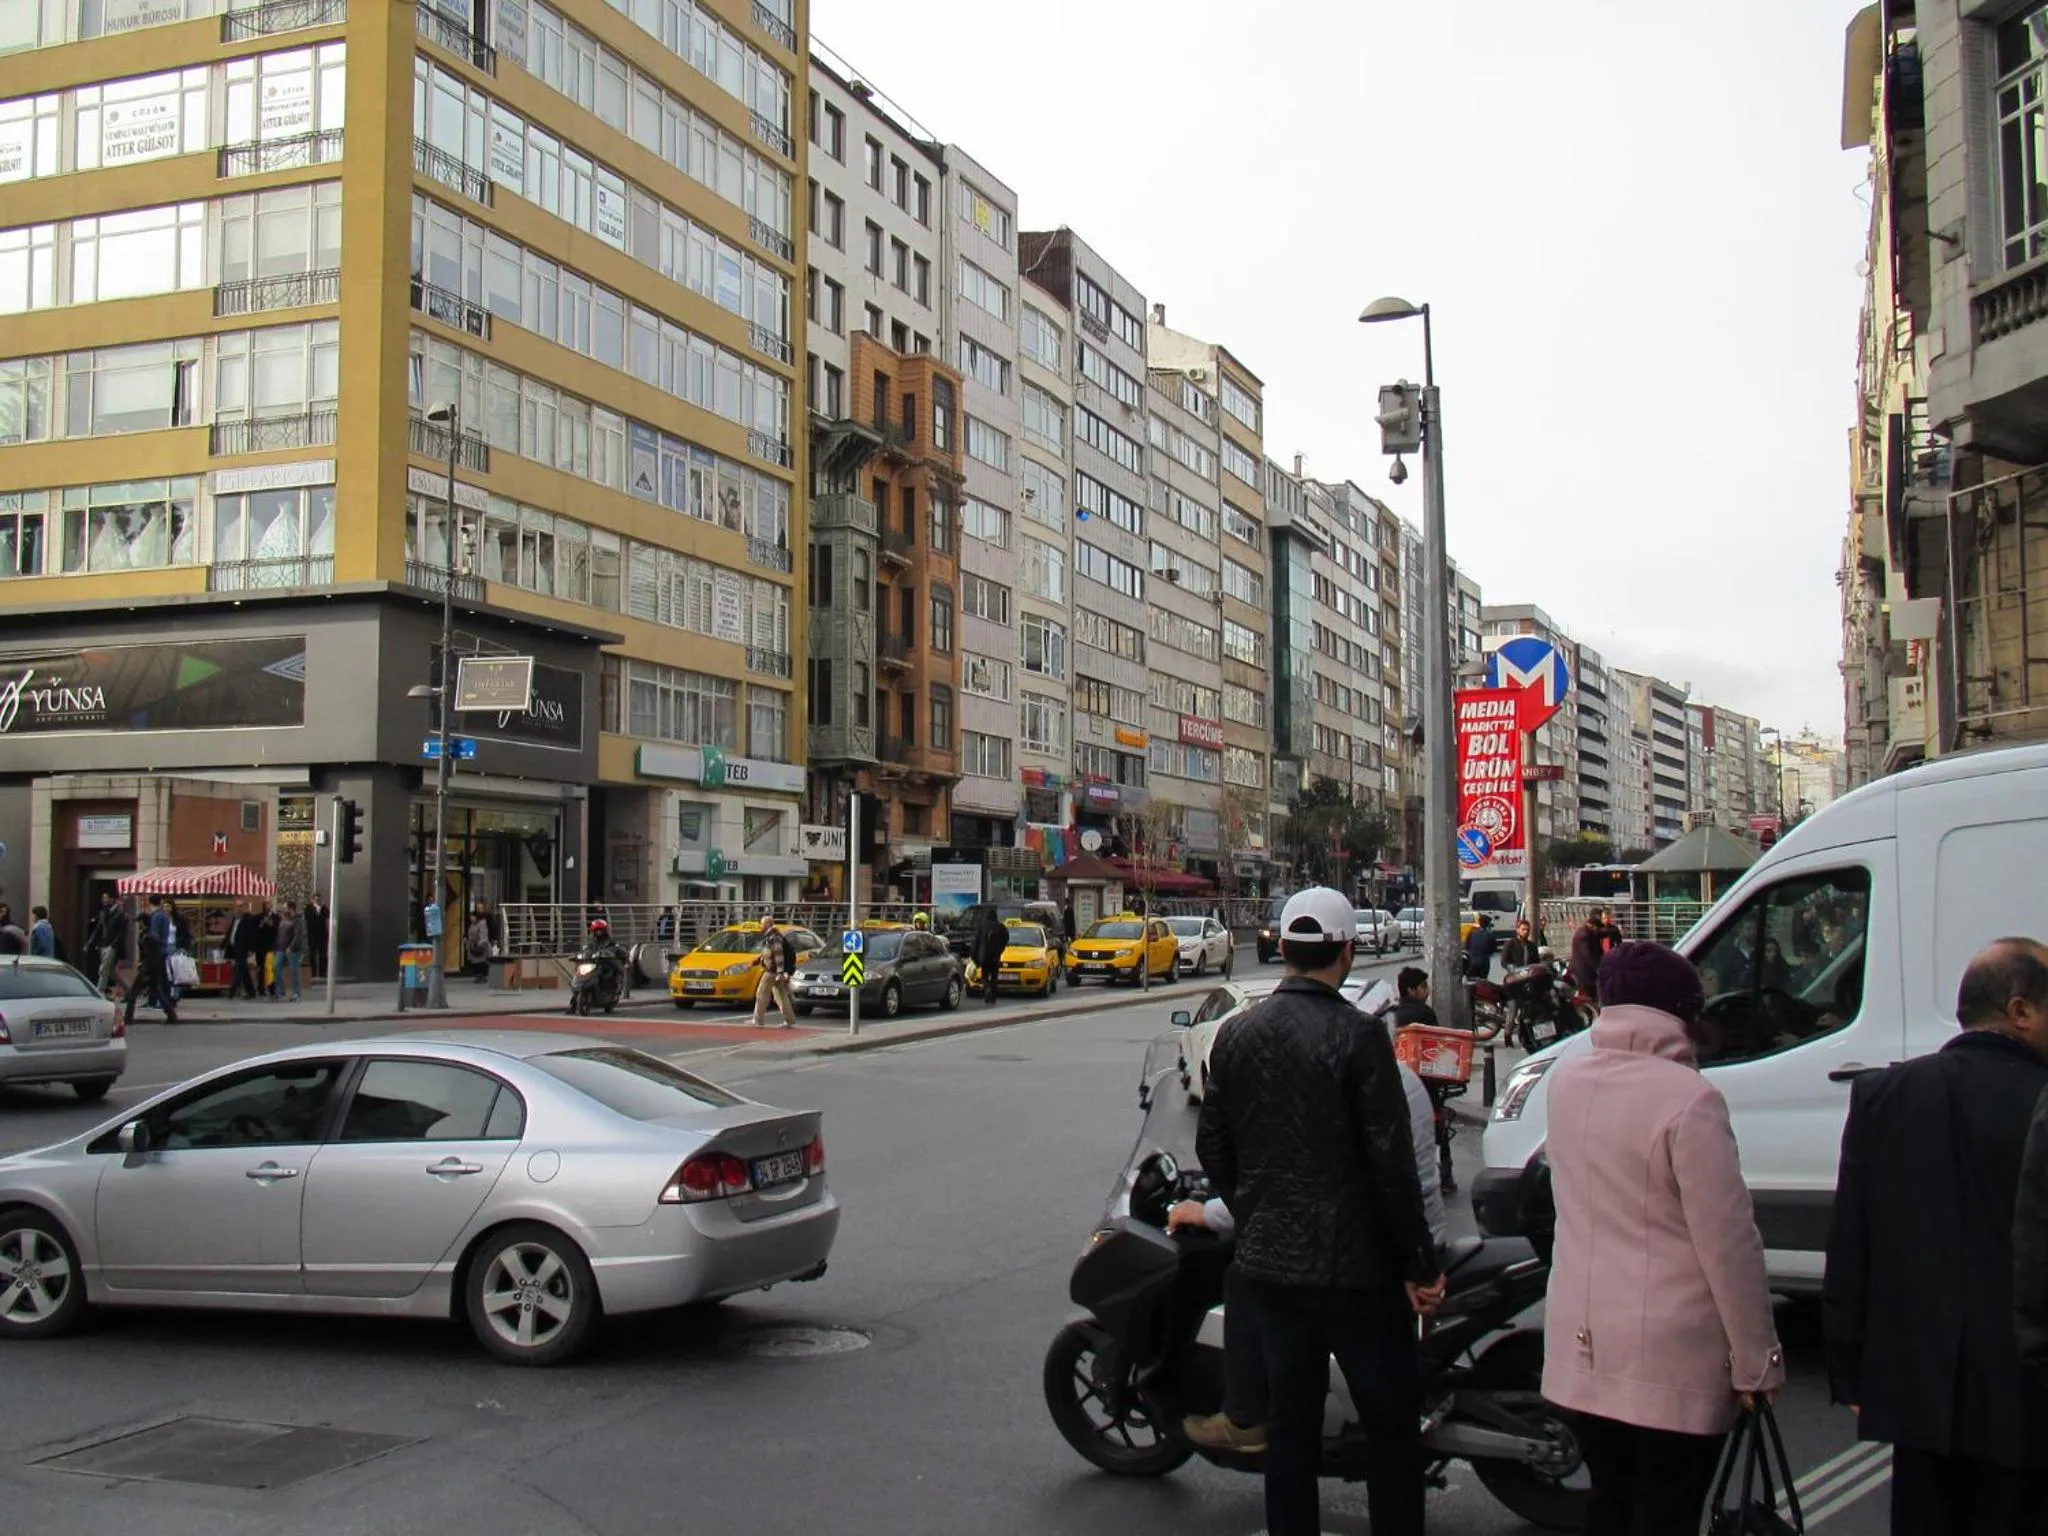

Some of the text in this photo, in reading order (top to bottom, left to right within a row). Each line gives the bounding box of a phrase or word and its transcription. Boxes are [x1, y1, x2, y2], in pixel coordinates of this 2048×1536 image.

[1460, 699, 1516, 719] MEDIA
[1181, 719, 1224, 745] TERCÜME
[1467, 733, 1509, 756] BOL
[726, 763, 749, 781] TEB
[1463, 757, 1516, 780] ÜRÜN
[823, 831, 846, 848] UNI
[724, 860, 739, 872] TEB
